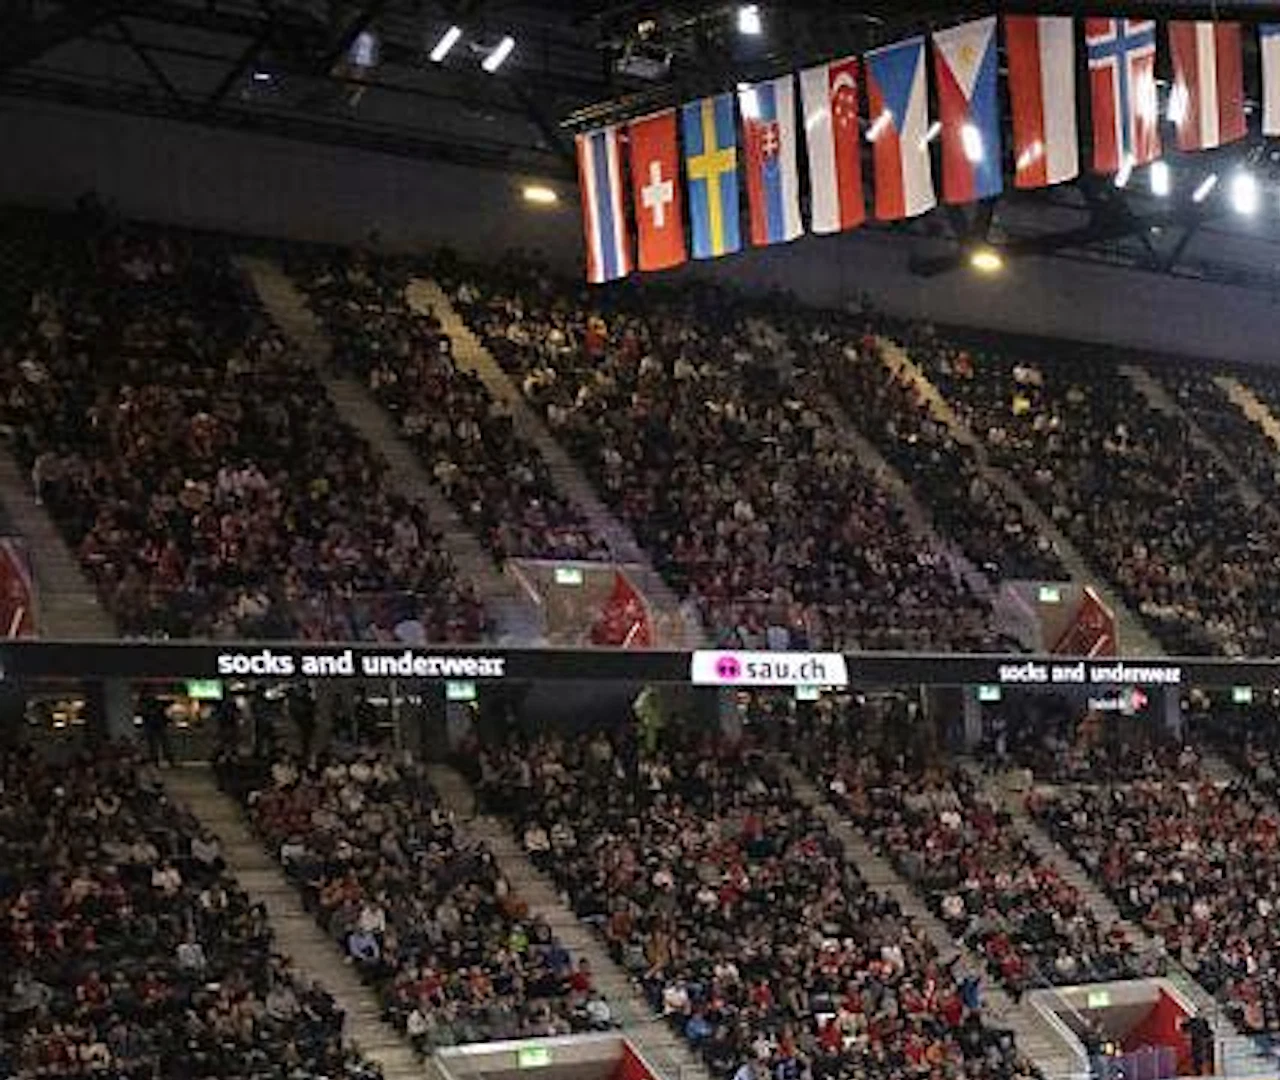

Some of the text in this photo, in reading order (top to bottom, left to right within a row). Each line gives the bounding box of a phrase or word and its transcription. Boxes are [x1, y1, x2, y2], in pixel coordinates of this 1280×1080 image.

[218, 649, 506, 677] socks and underwear
[747, 658, 826, 680] sau.ch
[1000, 662, 1047, 682] socks
[1052, 663, 1084, 682] and
